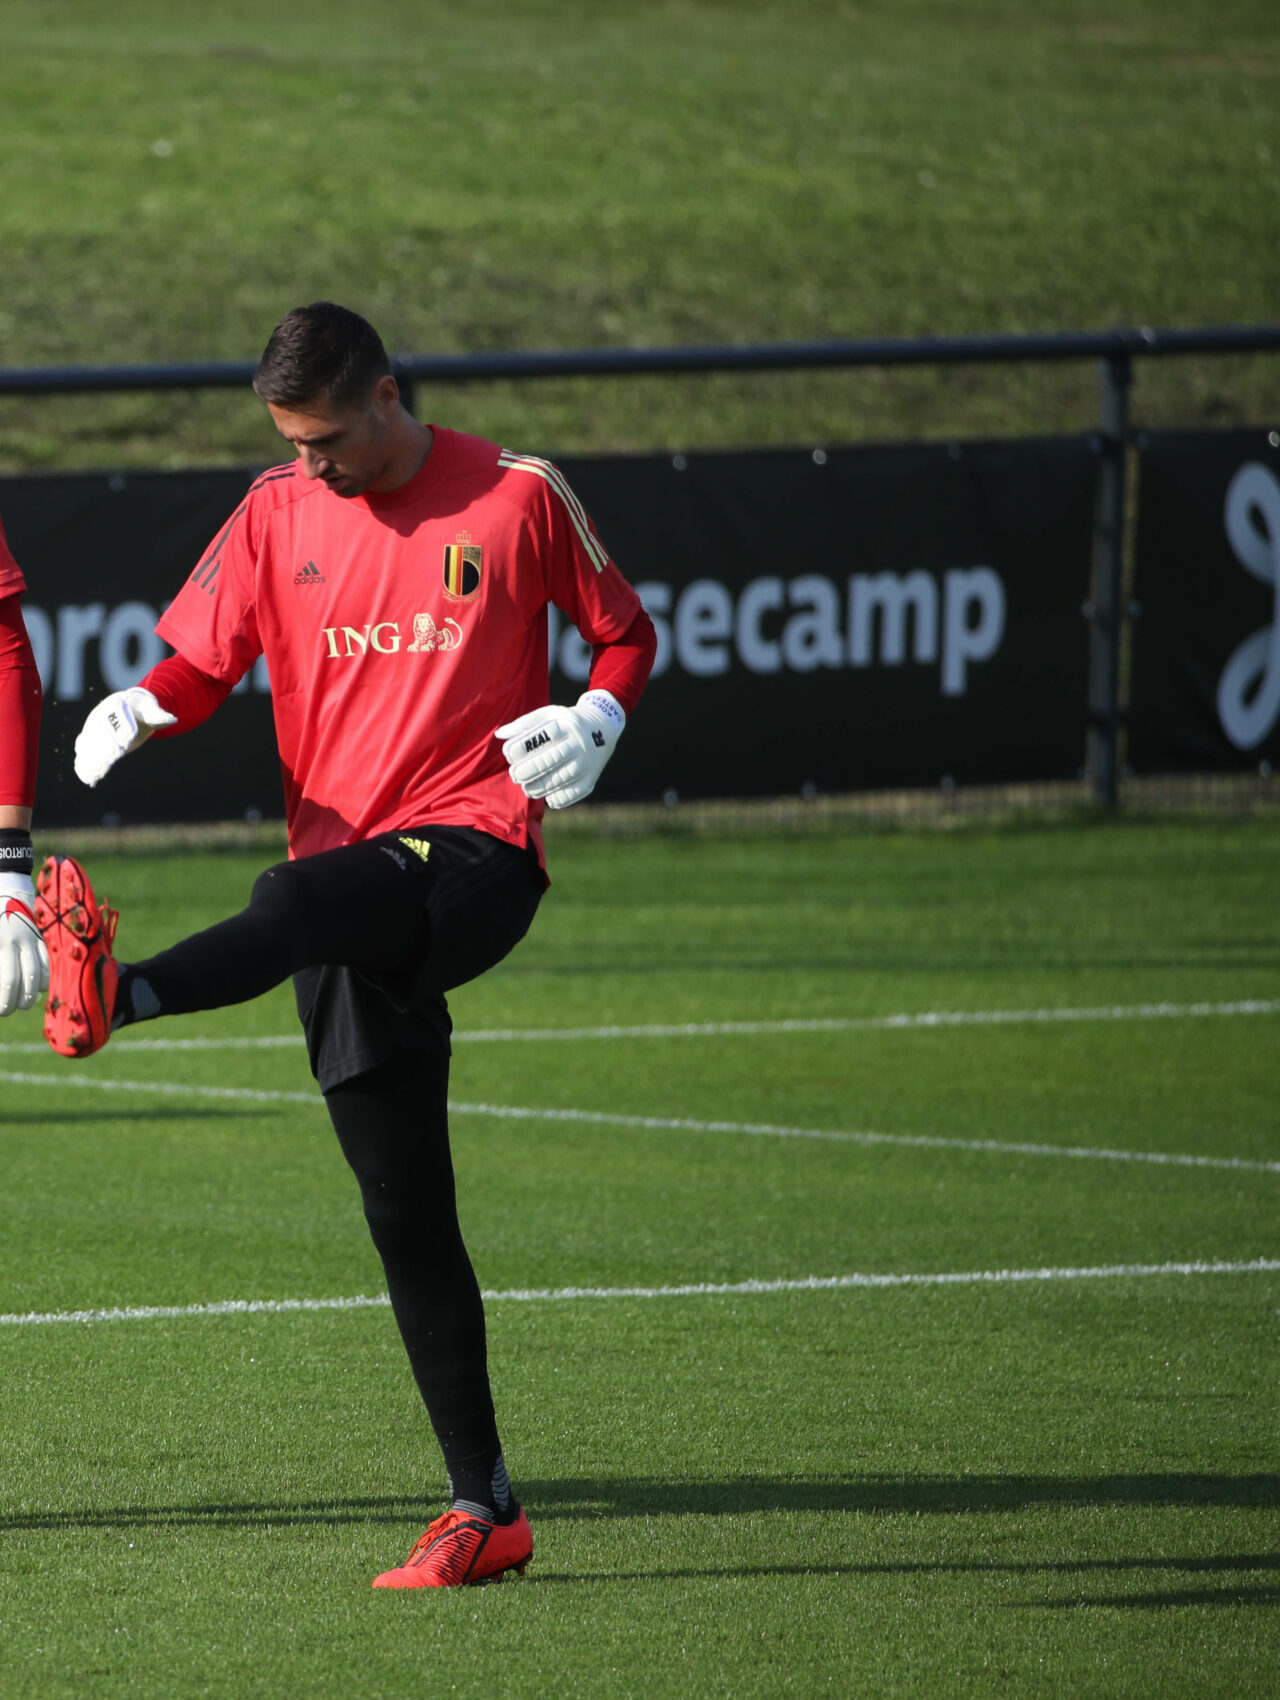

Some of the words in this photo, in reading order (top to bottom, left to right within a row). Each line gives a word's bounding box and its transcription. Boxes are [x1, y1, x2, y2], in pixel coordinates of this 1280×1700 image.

[322, 621, 402, 658] ING
[548, 564, 1006, 697] secamp
[524, 729, 552, 753] REAL
